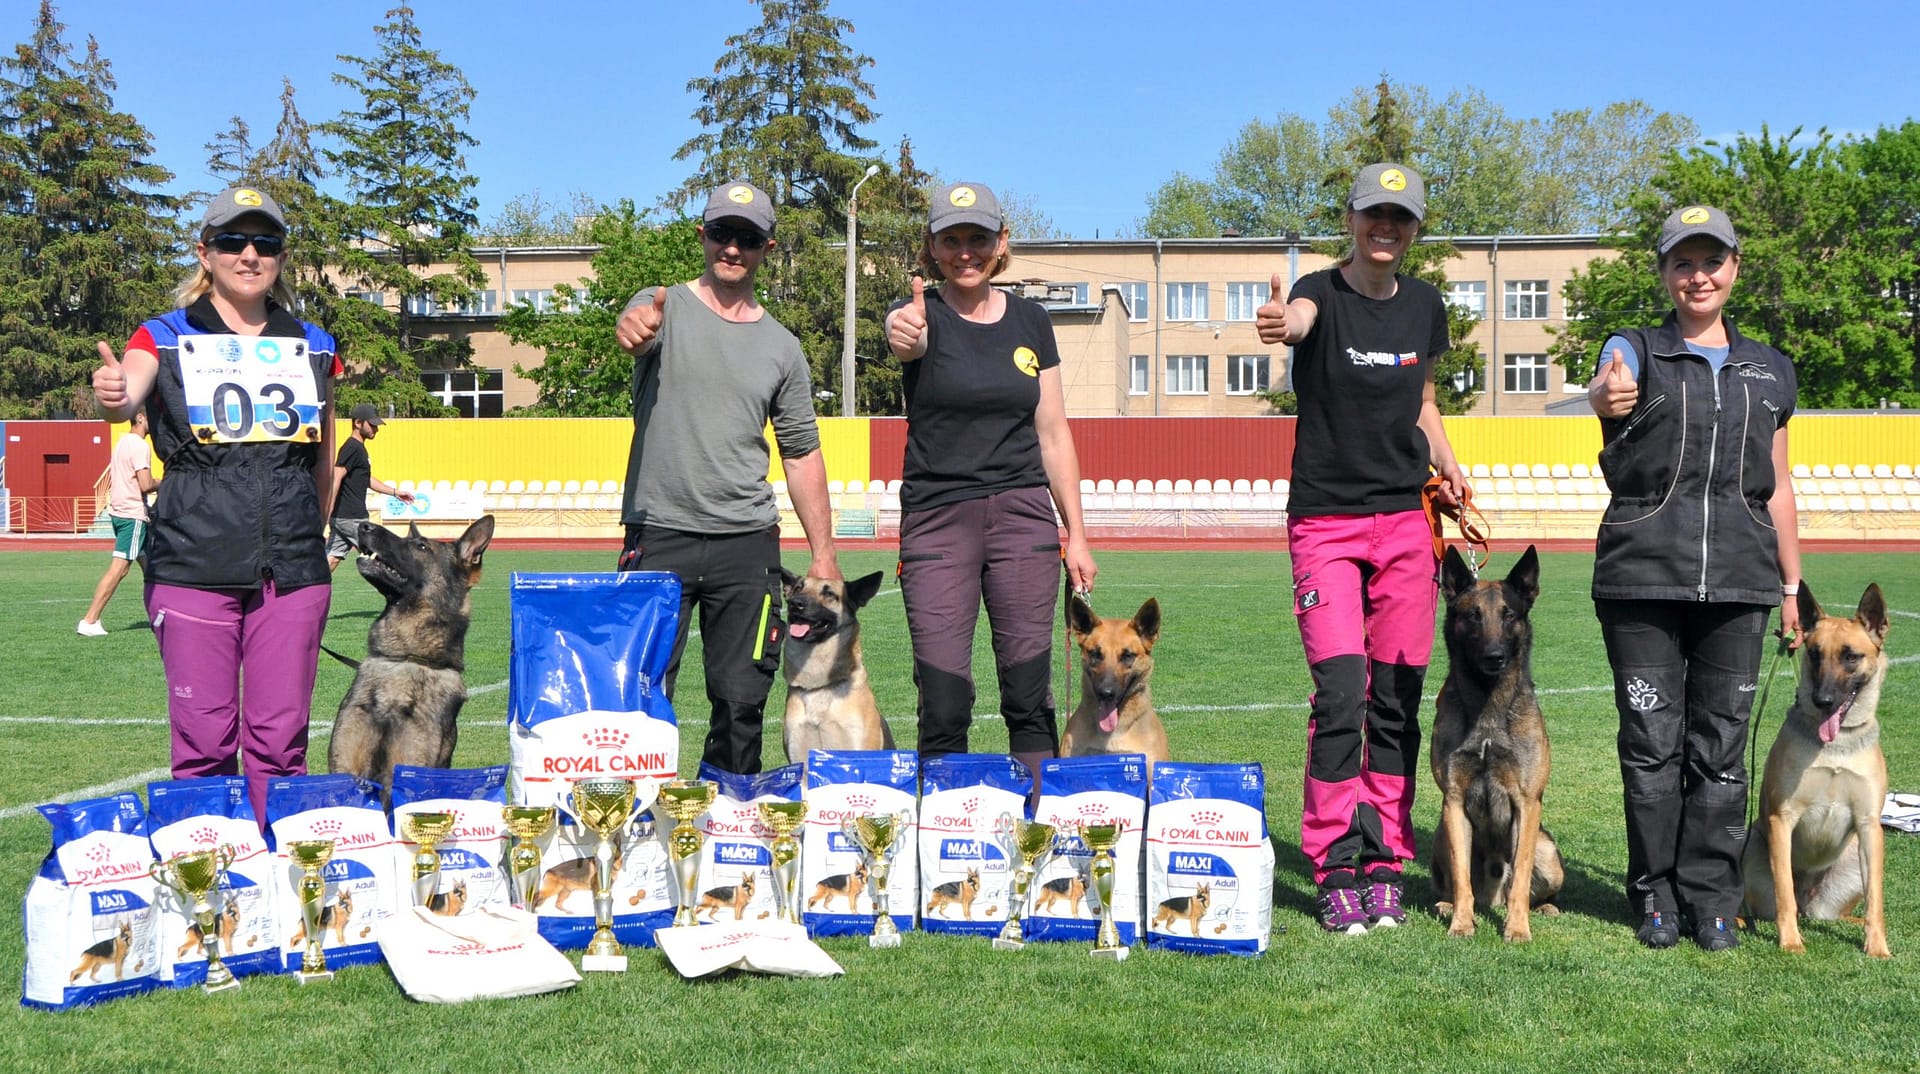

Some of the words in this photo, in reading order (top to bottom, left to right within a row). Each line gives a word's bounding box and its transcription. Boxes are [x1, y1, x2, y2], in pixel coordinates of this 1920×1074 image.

[212, 382, 300, 439] 03
[543, 755, 605, 774] ROYAL
[608, 752, 666, 772] CANIN
[452, 825, 497, 838] CANIN
[706, 819, 747, 834] ROYAL
[333, 832, 376, 847] CANIN
[1205, 829, 1249, 842] CANIN
[440, 852, 467, 865] AXI
[1175, 855, 1213, 870] MAXI
[983, 862, 1006, 872] Adult
[1214, 878, 1237, 889] Adult
